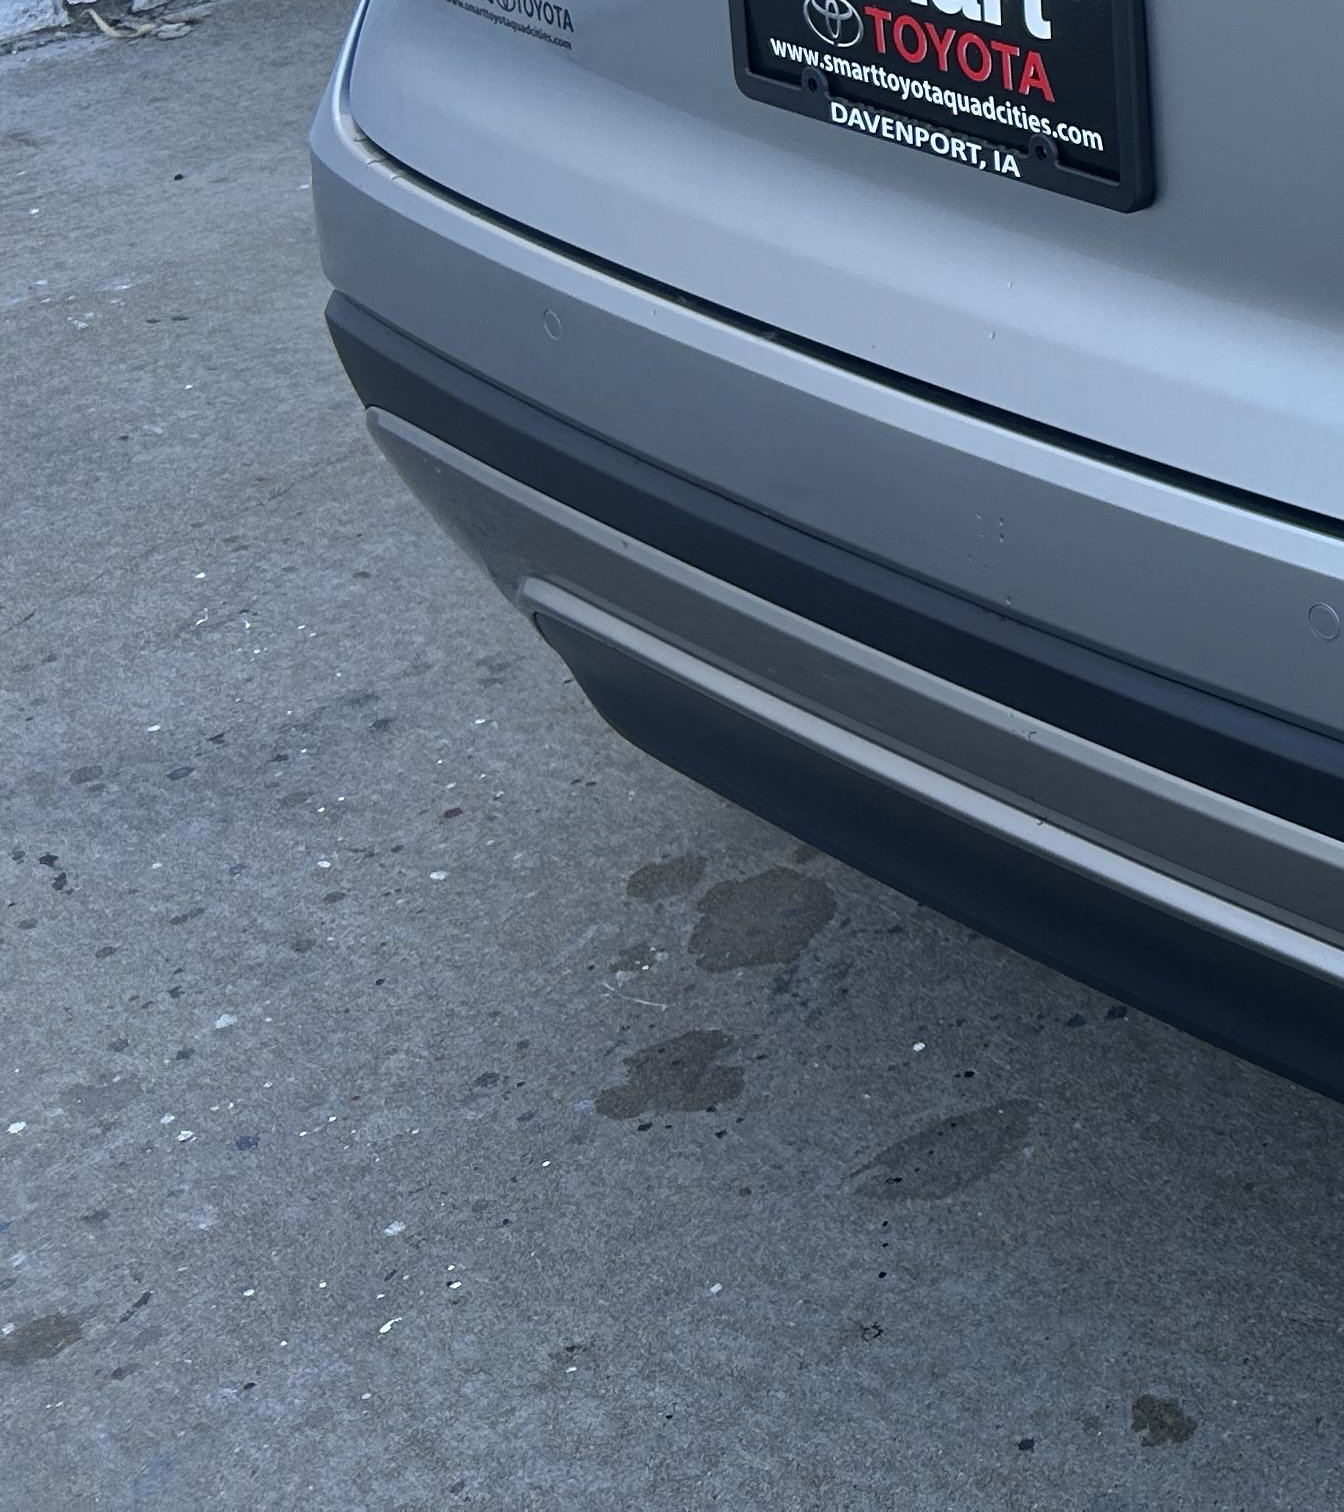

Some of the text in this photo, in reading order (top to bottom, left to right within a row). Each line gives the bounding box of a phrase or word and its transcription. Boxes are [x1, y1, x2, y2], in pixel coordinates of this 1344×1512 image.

[769, 37, 1104, 152] www.smarttoyotaquadcities.com
[864, 5, 1055, 103] TOYOTA
[830, 101, 1021, 178] DAVENPORT, IA
